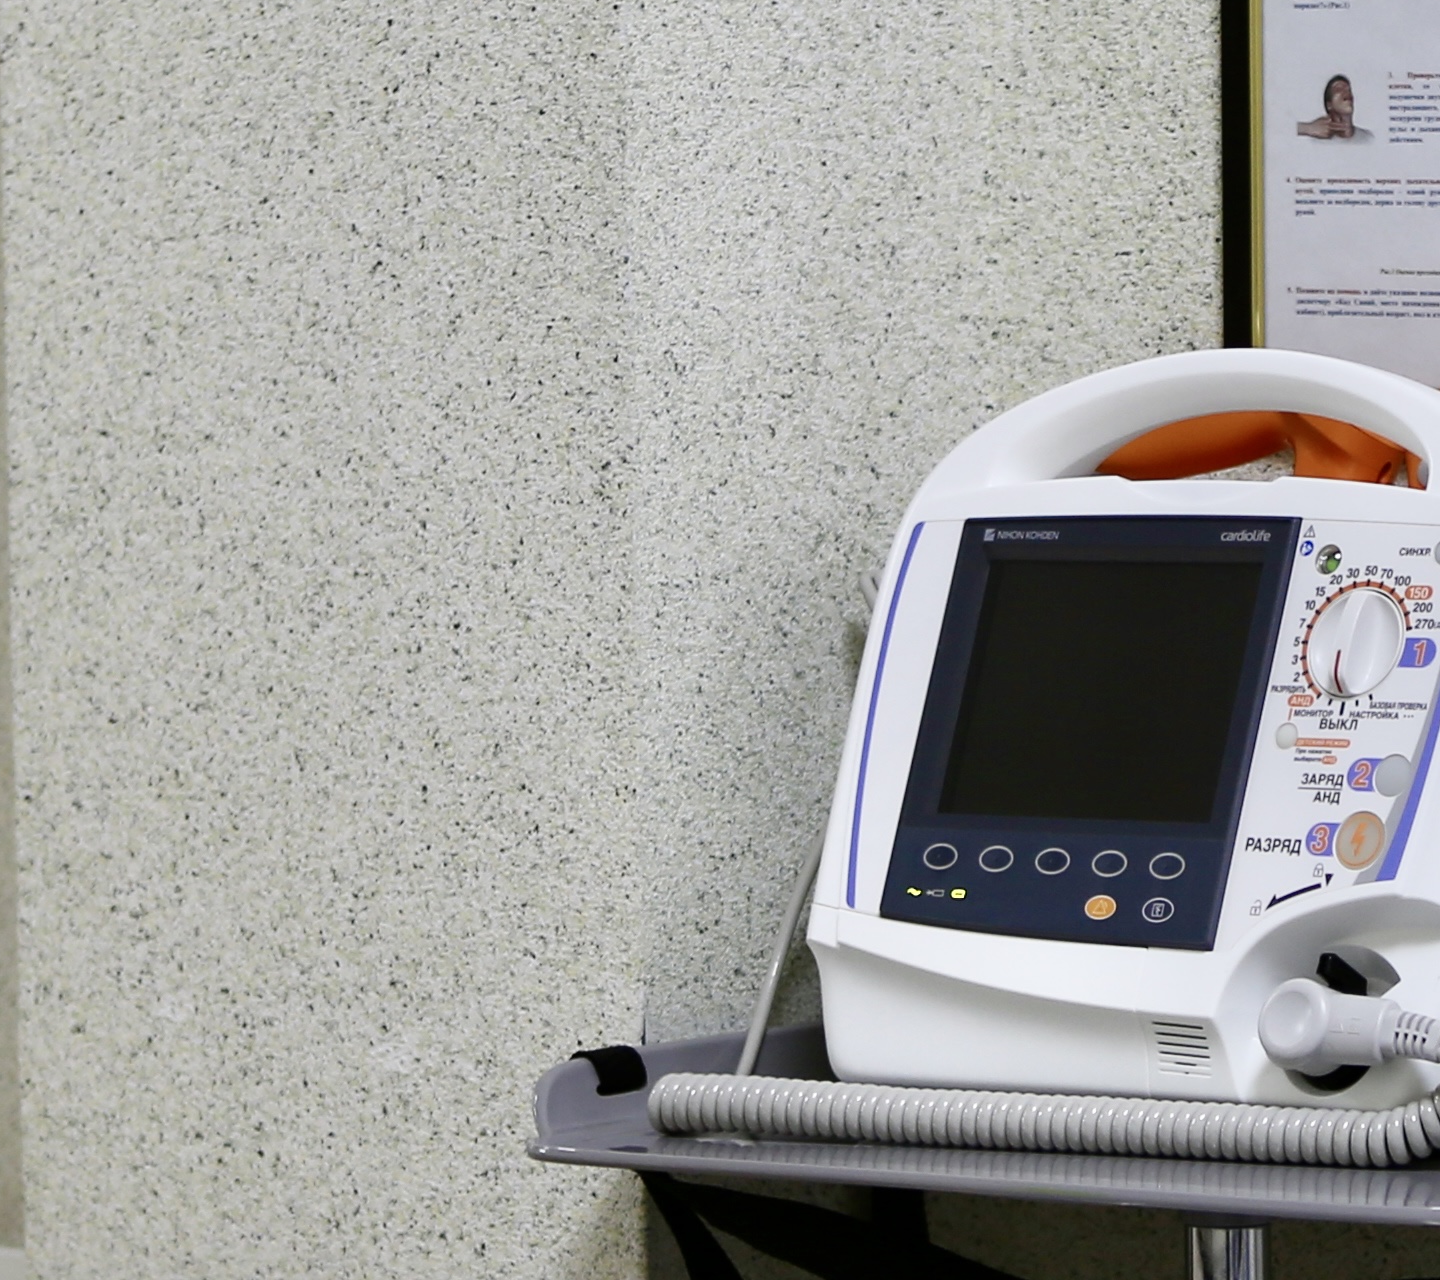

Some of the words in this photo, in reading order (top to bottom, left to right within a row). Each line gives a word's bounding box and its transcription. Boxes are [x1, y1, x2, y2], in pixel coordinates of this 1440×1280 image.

[997, 530, 1024, 540] NIHON
[1025, 530, 1060, 540] KOHDEN
[1220, 529, 1271, 542] cardiolife
[1399, 547, 1431, 557] СИНХР.
[1346, 568, 1360, 579] 30
[1364, 565, 1378, 576] 50
[1380, 569, 1394, 580] 70
[1329, 574, 1343, 586] 20
[1394, 575, 1411, 586] 100
[1315, 586, 1326, 597] 15
[1409, 587, 1428, 599] 150
[1305, 600, 1316, 611] 10
[1412, 602, 1433, 613] 200
[1299, 619, 1306, 628] 7
[1293, 636, 1300, 646] 5
[1413, 640, 1427, 666] 1
[1291, 655, 1298, 665] 3
[1293, 672, 1301, 682] 2
[1289, 696, 1311, 707] АНД
[1293, 709, 1334, 718] МОНИТОР
[1349, 710, 1399, 720] НАСТРОЙКА
[1319, 719, 1358, 730] ВЫКЛ
[1351, 762, 1372, 787] 2
[1301, 774, 1344, 787] ЗАРЯД
[1313, 792, 1341, 805] АНД
[1310, 826, 1329, 853] 3
[1245, 837, 1301, 856] РАЗРЯД
